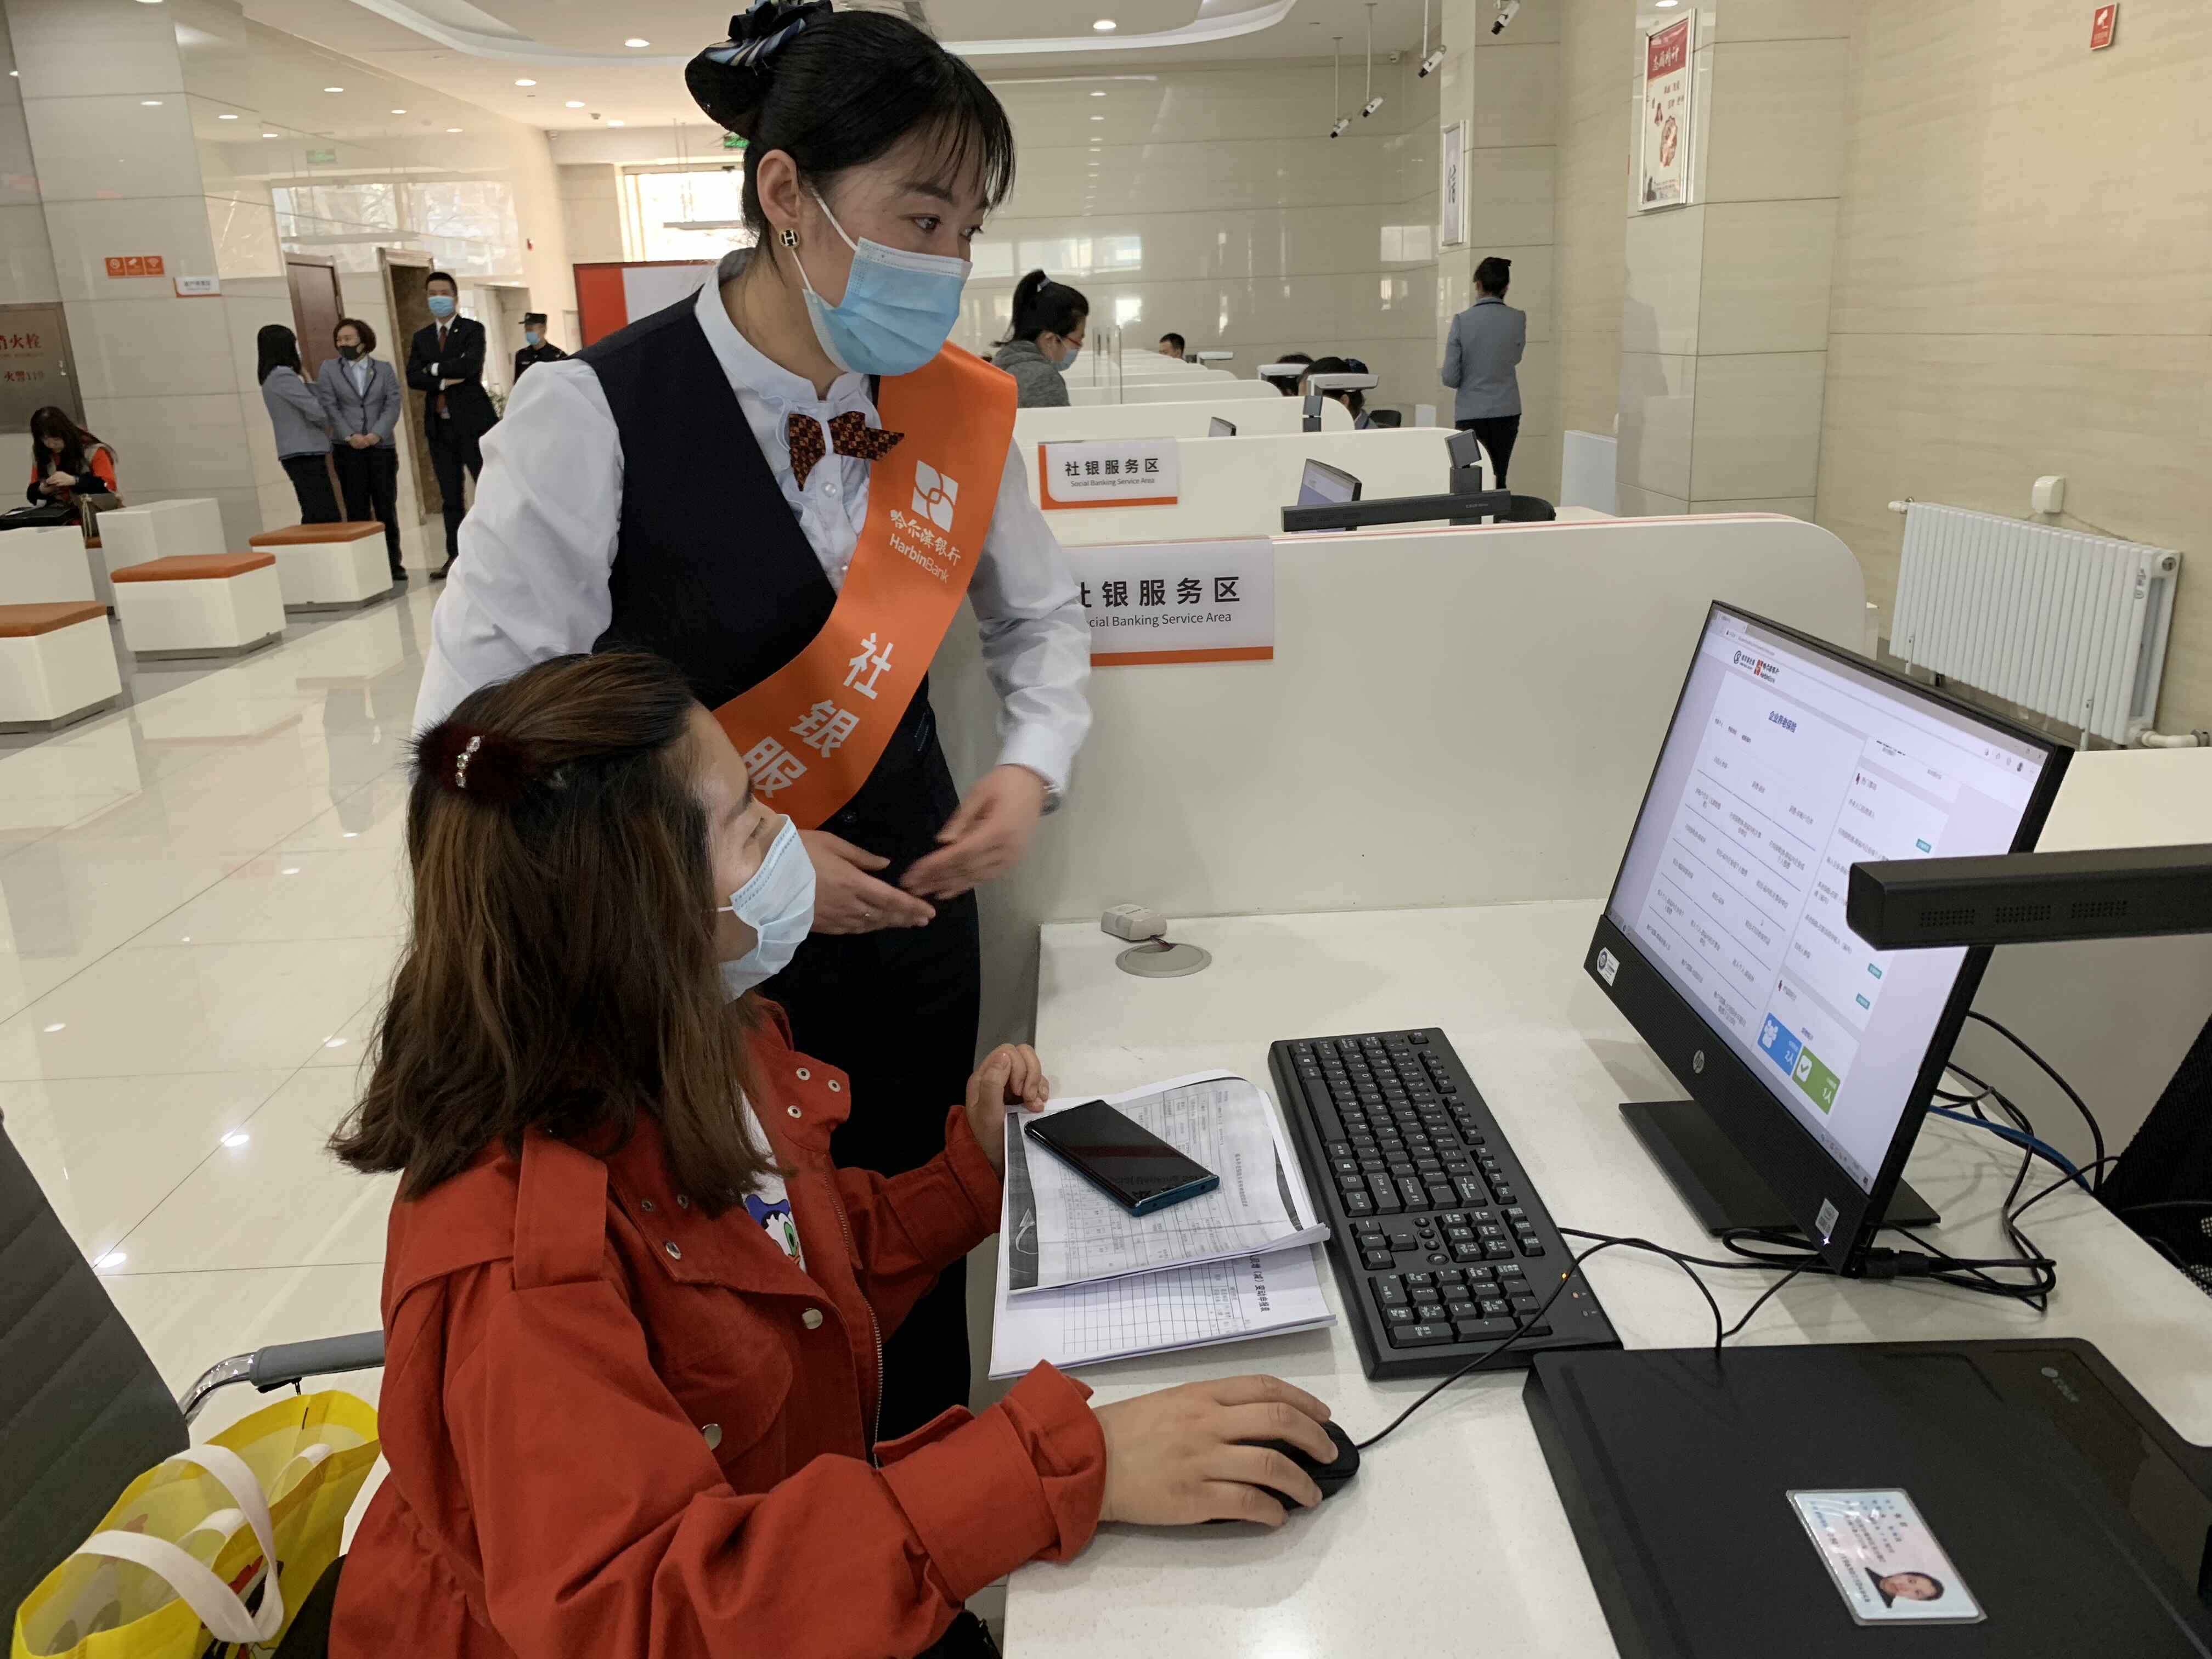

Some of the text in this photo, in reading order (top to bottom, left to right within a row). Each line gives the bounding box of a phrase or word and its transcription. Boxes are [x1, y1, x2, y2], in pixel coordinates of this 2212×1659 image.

[1065, 458, 1159, 476] 社银服务区
[890, 509, 961, 567] 哈尔滨银行
[889, 533, 950, 584] HarbinBank
[1088, 612, 1232, 628] cial Banking Service Area
[1768, 711, 1797, 733] 企业养老保险
